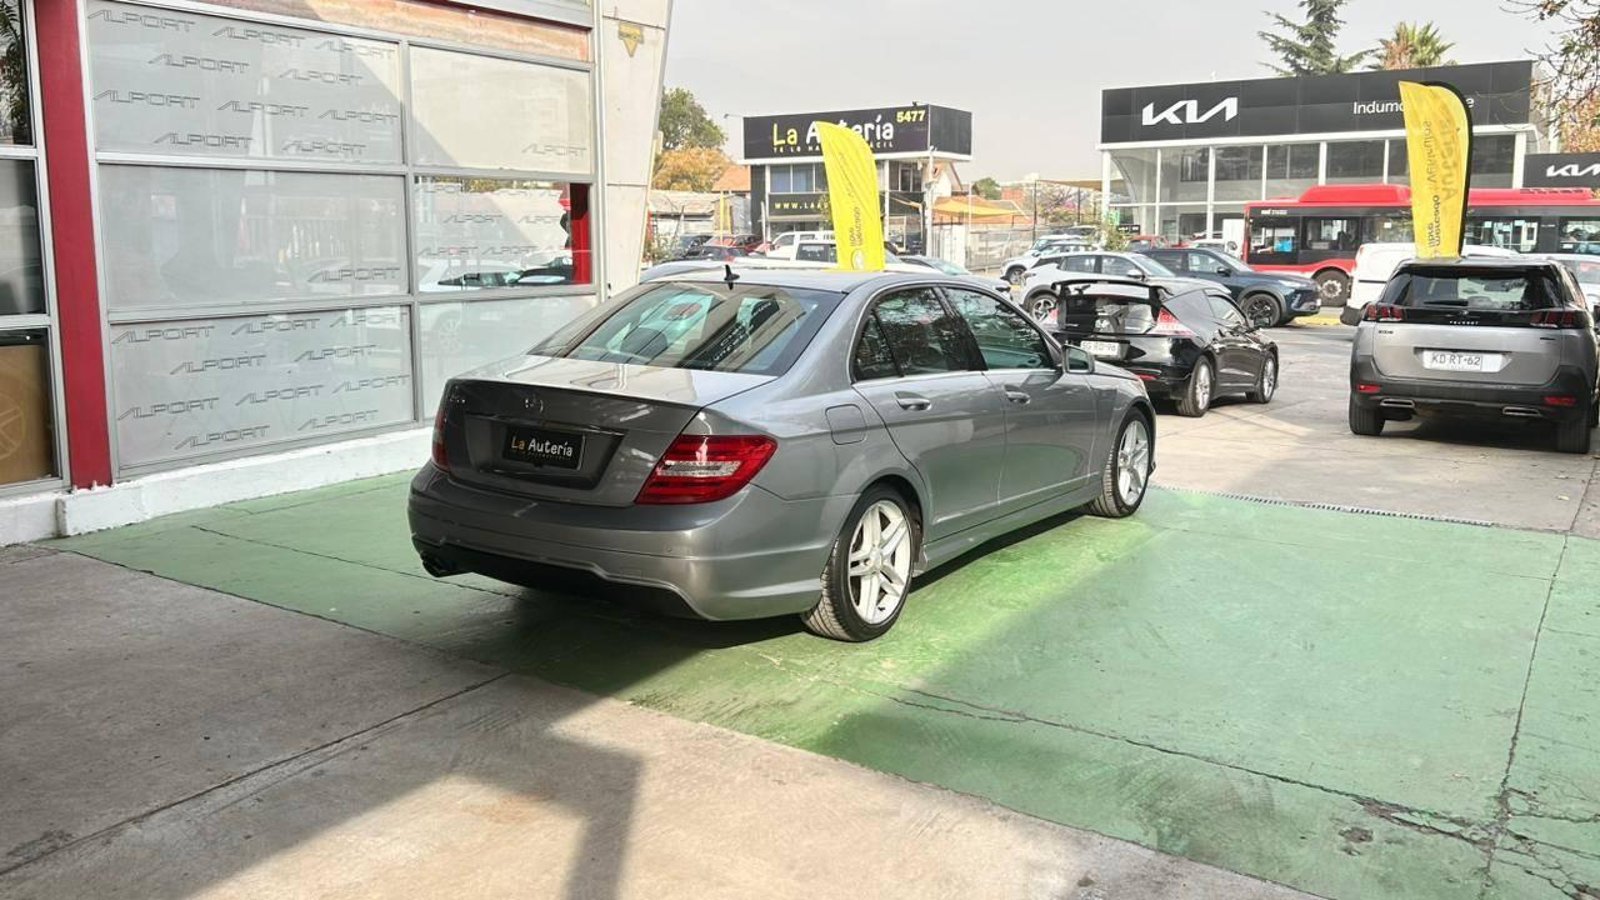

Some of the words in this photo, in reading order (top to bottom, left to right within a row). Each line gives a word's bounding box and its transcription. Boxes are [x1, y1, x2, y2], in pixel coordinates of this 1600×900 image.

[88, 9, 196, 33] ALPORT
[212, 26, 305, 47] ALPORT
[315, 40, 396, 59] ALPORT
[148, 53, 249, 74] ALPORT
[279, 68, 363, 86] ALPORT
[93, 89, 200, 109] ALPORT
[1353, 100, 1405, 114] Indumo
[216, 100, 309, 118] ALPORT
[318, 109, 398, 124] ALPORT
[896, 110, 926, 123] 5477
[1142, 97, 1238, 126] KIA
[773, 123, 797, 146] La
[806, 114, 894, 145] Aería
[153, 132, 254, 148] ALPORT
[282, 140, 366, 156] ALPORT
[1546, 164, 1600, 176] KIA
[308, 267, 400, 282] ALPORT
[111, 325, 215, 344] ALPORT
[231, 318, 320, 335] ALPORT
[294, 345, 376, 362] ALPORT
[1432, 353, 1445, 363] KD
[170, 354, 267, 375] ALPORT
[332, 374, 410, 394] ALPORT
[235, 384, 324, 406] ALPORT
[117, 397, 219, 421] ALPORT
[298, 409, 378, 431] ALPORT
[174, 425, 270, 450] ALPORT
[512, 436, 525, 450] La
[528, 438, 573, 456] Autería
